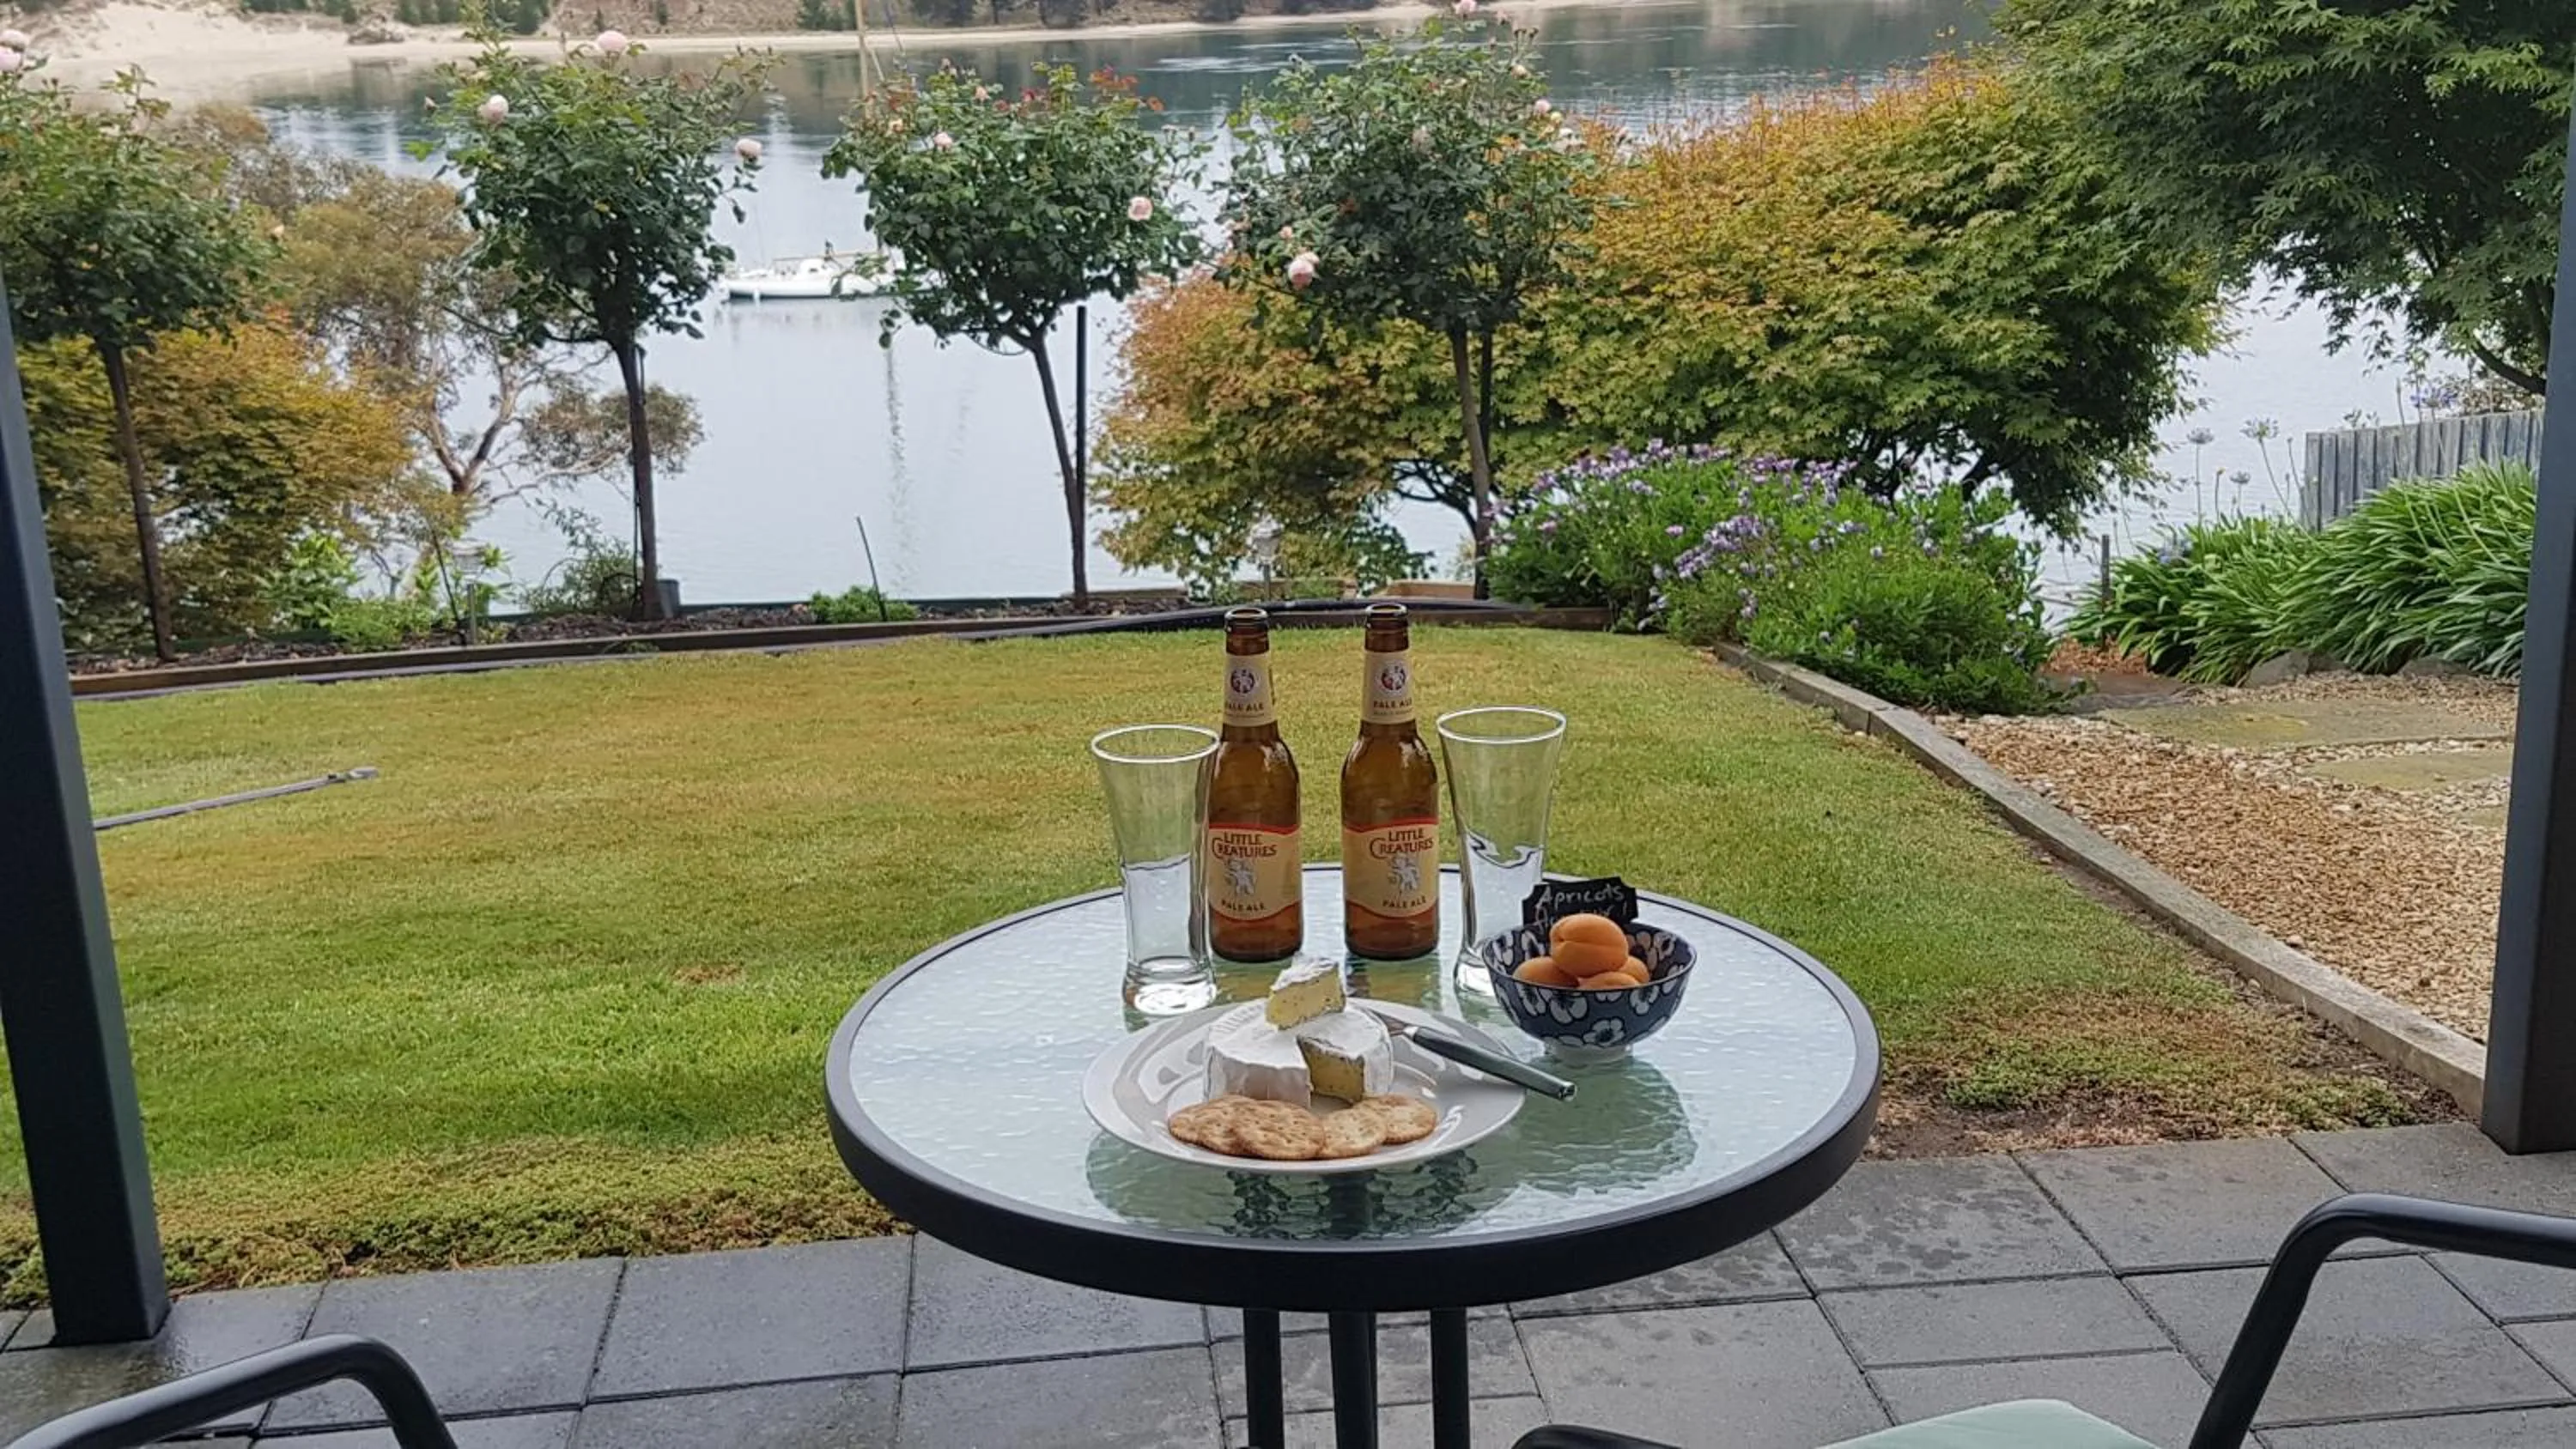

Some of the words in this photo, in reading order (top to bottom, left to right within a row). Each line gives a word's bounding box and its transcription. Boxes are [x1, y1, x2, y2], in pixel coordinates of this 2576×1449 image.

[1224, 831, 1262, 846] LITTLE
[1388, 828, 1425, 842] LITTLE
[1212, 837, 1278, 859] CREATURES
[1369, 837, 1434, 859] CREATURES
[1382, 900, 1406, 909] PALE
[1410, 895, 1427, 907] ALE
[1534, 883, 1625, 911] Apricots
[1221, 899, 1244, 911] PALE
[1246, 902, 1265, 912] ALE
